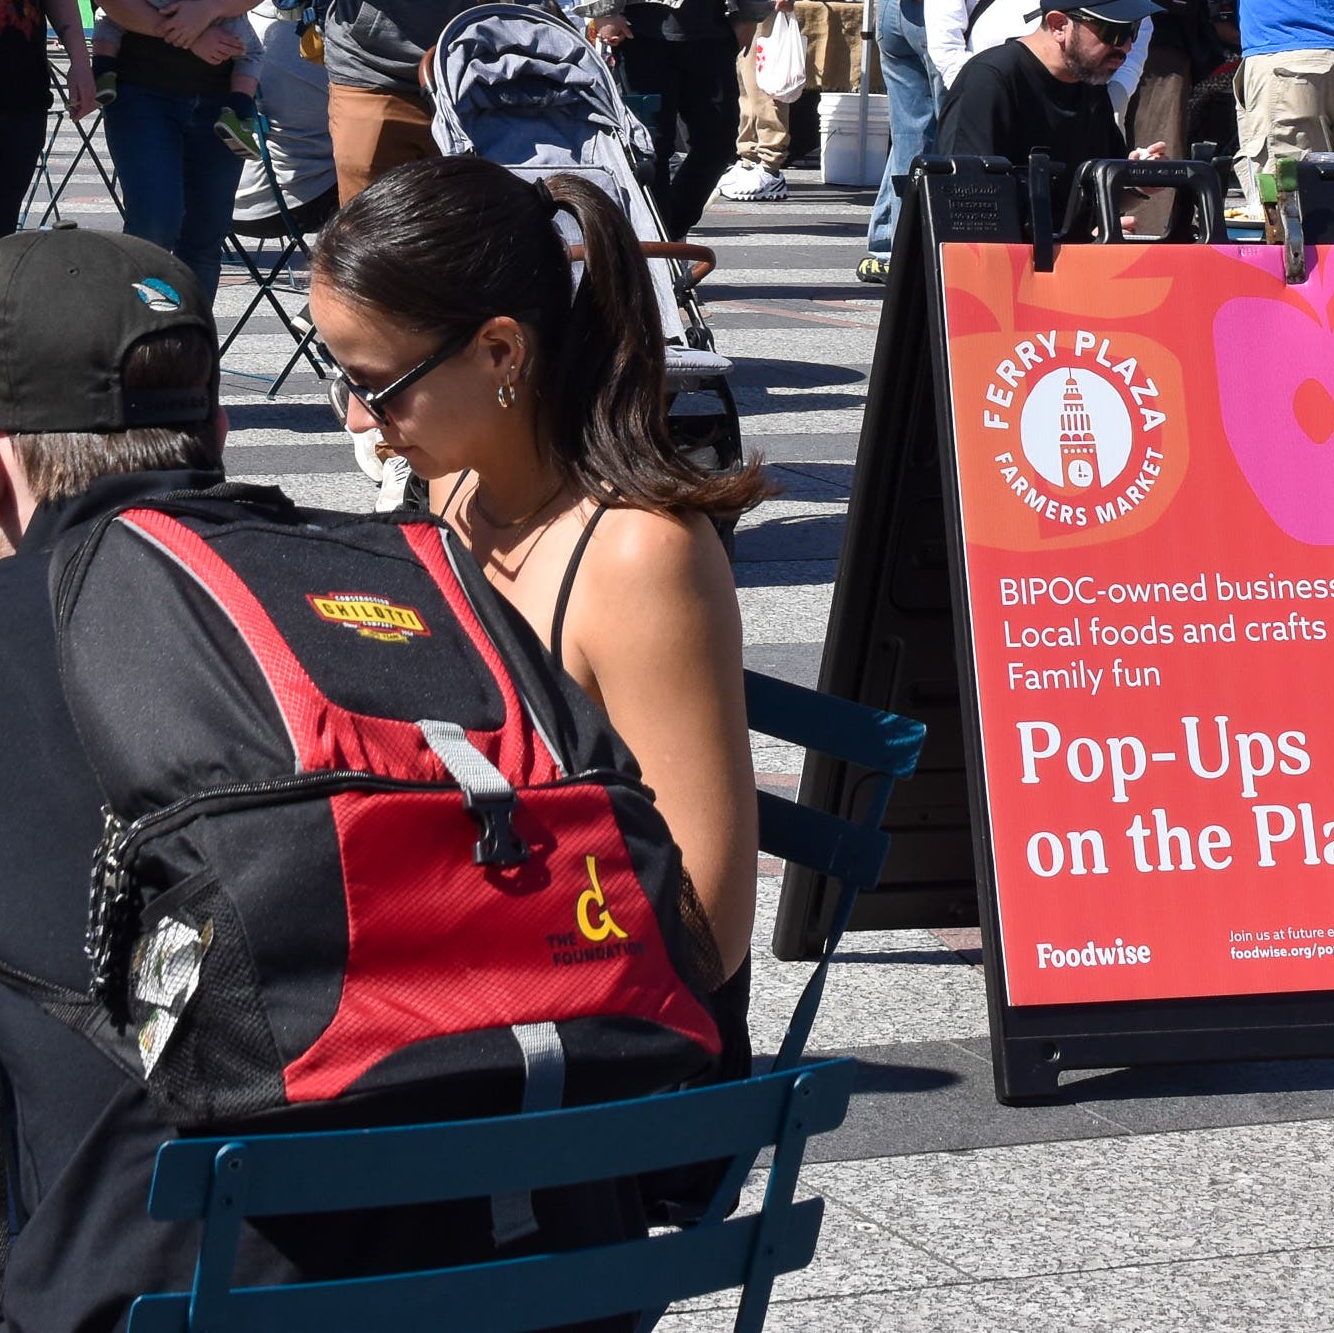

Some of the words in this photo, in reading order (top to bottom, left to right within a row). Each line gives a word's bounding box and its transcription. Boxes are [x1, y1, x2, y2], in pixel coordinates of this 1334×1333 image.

[983, 329, 1057, 430] FERRY
[1074, 329, 1167, 432] PLAZA
[994, 451, 1088, 526] FARMERS
[1094, 446, 1164, 524] MARKET
[1000, 575, 1207, 606] BIPOC-owned
[322, 603, 416, 626] GHILOTTI
[1004, 618, 1081, 649] Local
[1089, 617, 1175, 645] foods
[1183, 614, 1237, 643] and
[1245, 611, 1328, 641] crafts
[1008, 659, 1104, 696] Family
[1111, 658, 1162, 688] fun
[1015, 716, 1312, 803] Pop-Ups
[1027, 826, 1109, 878] on
[1125, 808, 1233, 873] the
[552, 942, 644, 966] FOUNDATION
[1036, 938, 1152, 969] Foodwise
[1229, 930, 1253, 943] Join
[1258, 933, 1272, 941] us
[1273, 931, 1286, 941] at
[1287, 927, 1324, 939] future
